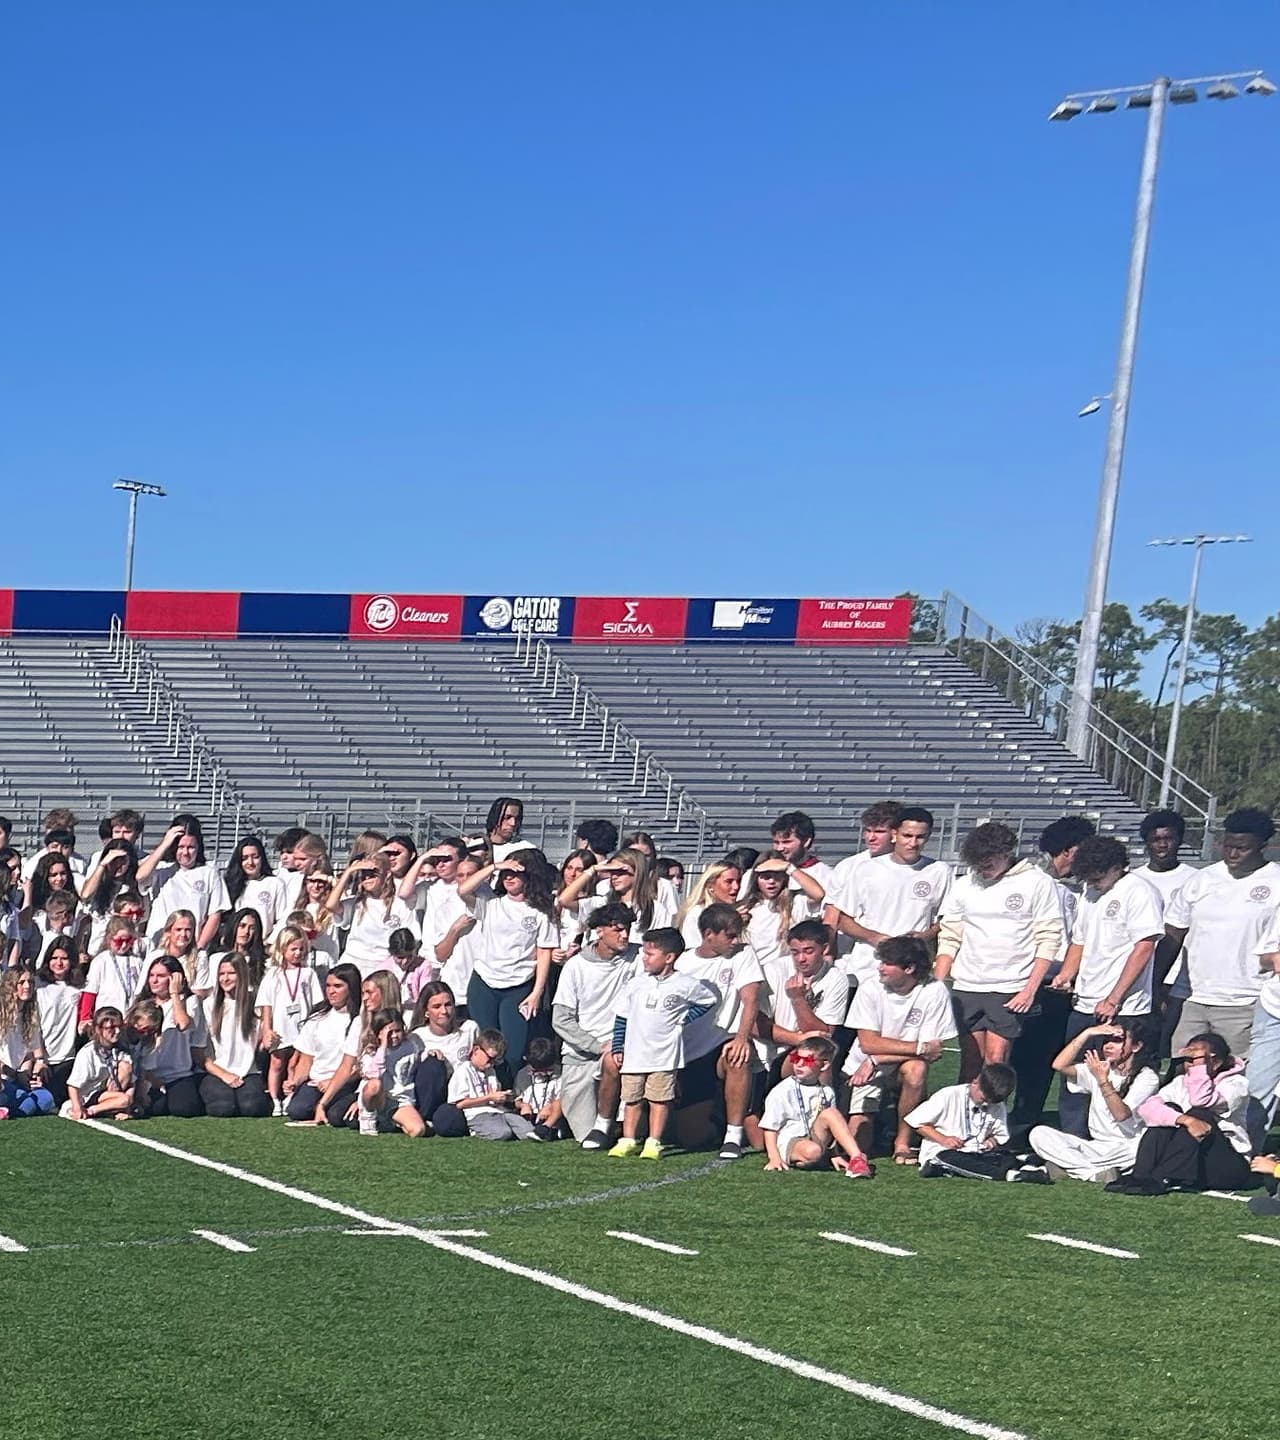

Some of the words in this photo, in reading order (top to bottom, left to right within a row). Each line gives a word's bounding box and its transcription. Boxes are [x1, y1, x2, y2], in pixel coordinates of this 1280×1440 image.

[368, 603, 394, 624] Tide
[401, 606, 449, 623] Cleaners
[513, 597, 560, 618] GATOR
[535, 619, 558, 632] CARS
[602, 622, 654, 634] SIGMA
